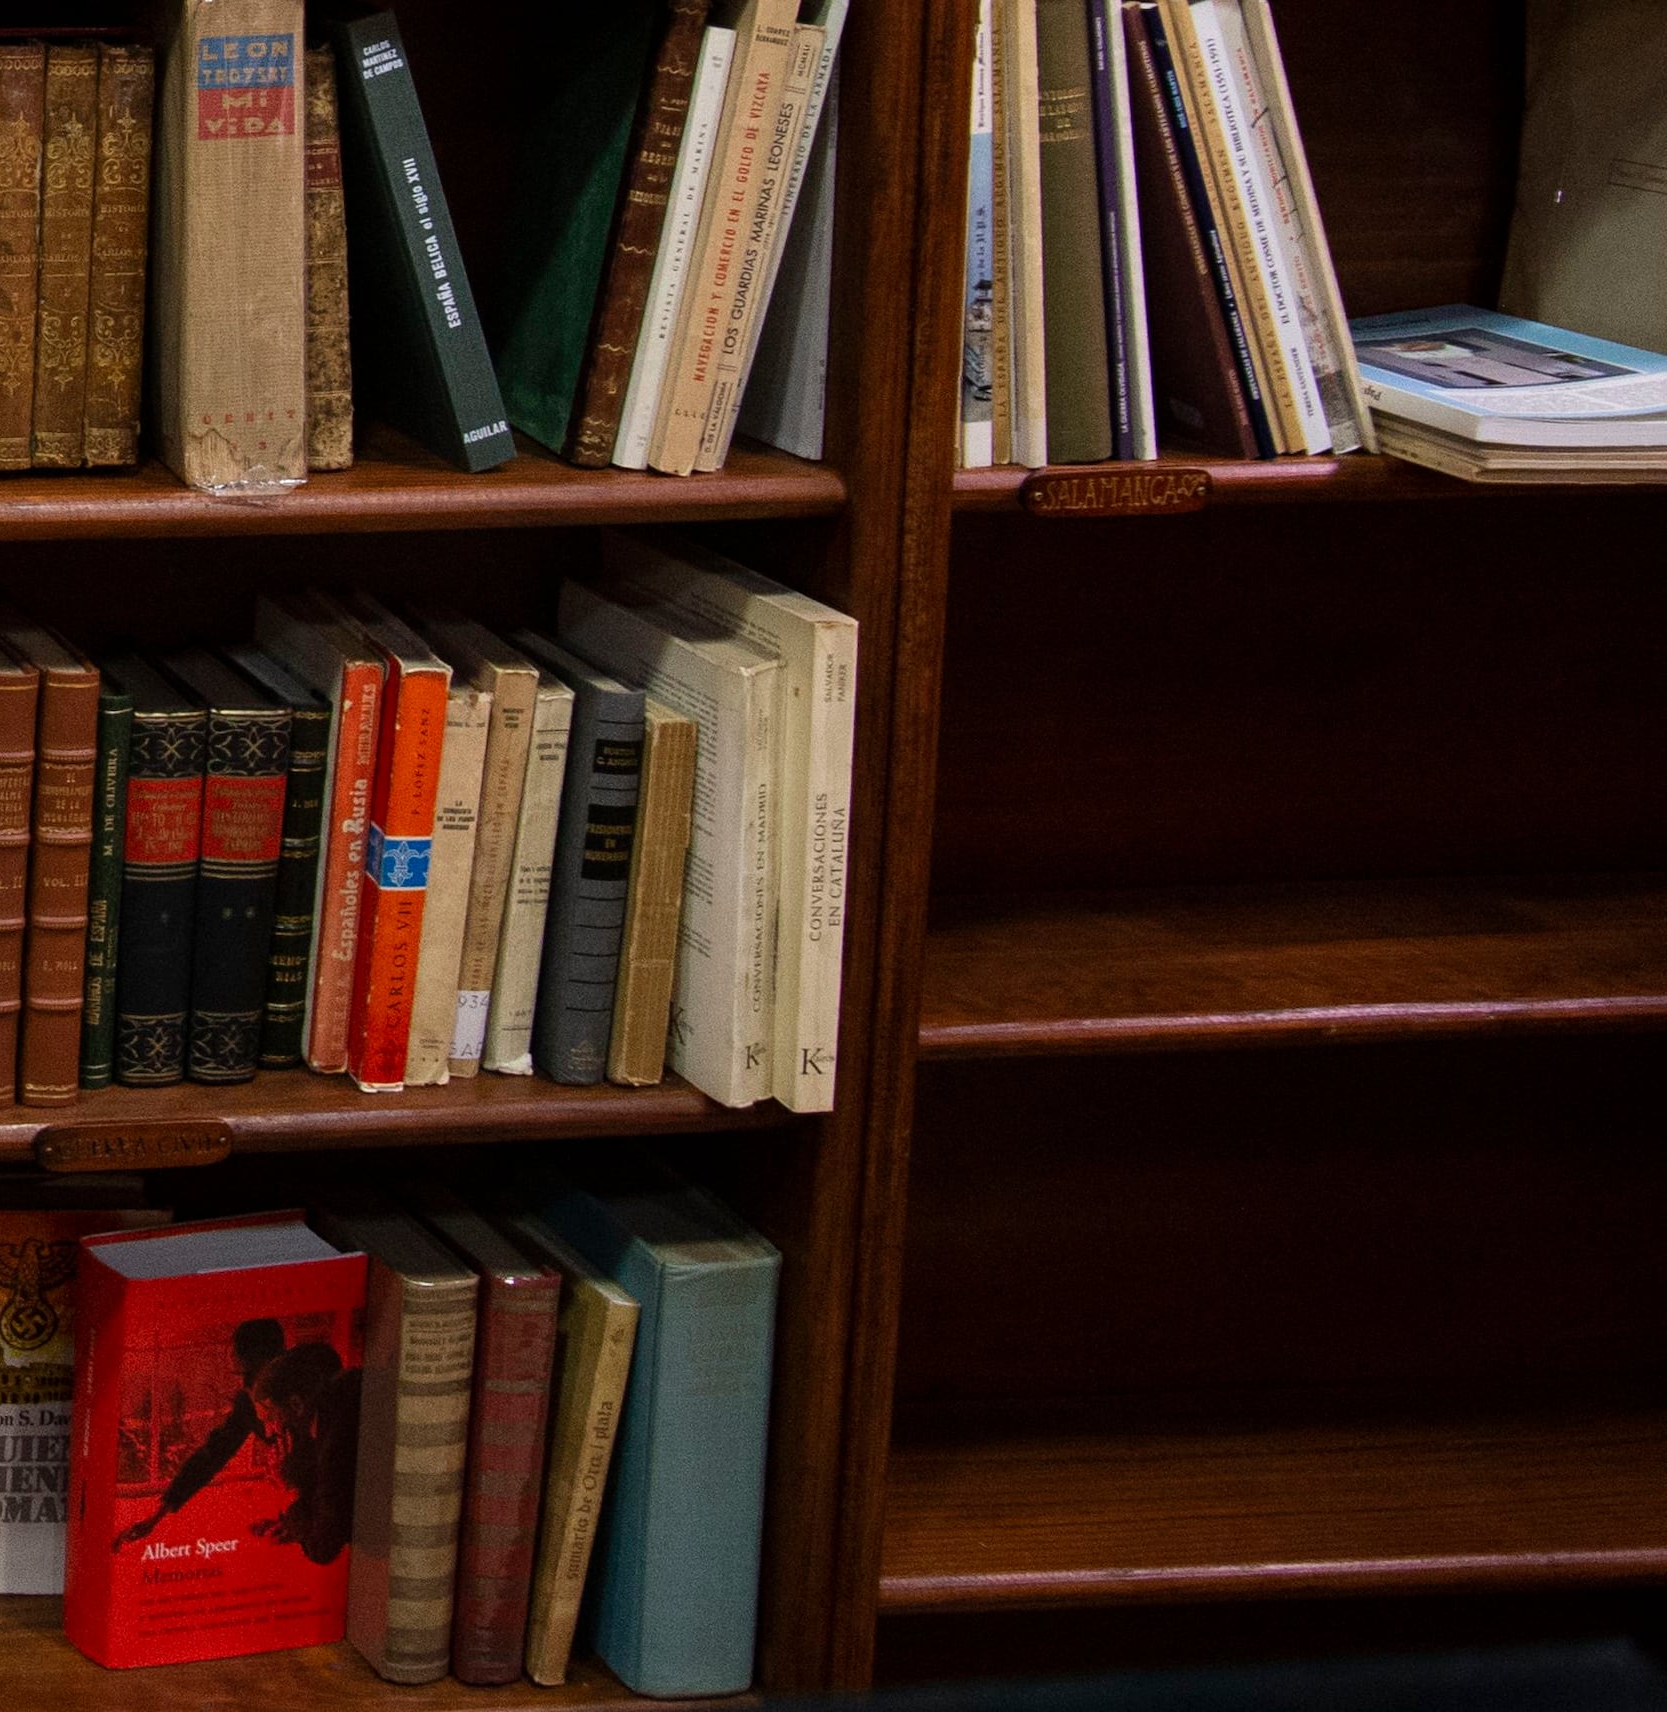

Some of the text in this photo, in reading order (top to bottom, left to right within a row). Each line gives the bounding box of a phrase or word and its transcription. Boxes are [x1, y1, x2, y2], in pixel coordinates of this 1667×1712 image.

[201, 39, 289, 61] LEON
[410, 181, 462, 329] ESPAÑA BELICA siglo
[693, 71, 771, 382] NAVEGACION COMERCIO GOLFO VIZCAYA
[721, 102, 794, 356] LOS GUARDIAS MARINAS LEONESES
[1222, 96, 1287, 308] DOCTOR COSME MEDINA BIBLIOTECA
[462, 421, 507, 444] AGUILAR
[1042, 473, 1174, 508] SALAMANCA
[103, 747, 118, 832] DE OLIVEIRA
[90, 899, 108, 943] ESPAÑA
[331, 778, 368, 961] Españoles en Rusia
[752, 783, 767, 1013] CONVERSACIONES MADRID
[809, 793, 846, 942] CONVERSACIONES EN CATALUÑA
[385, 901, 413, 1027] CARLOS VII
[140, 1536, 240, 1563] Albert Speer
